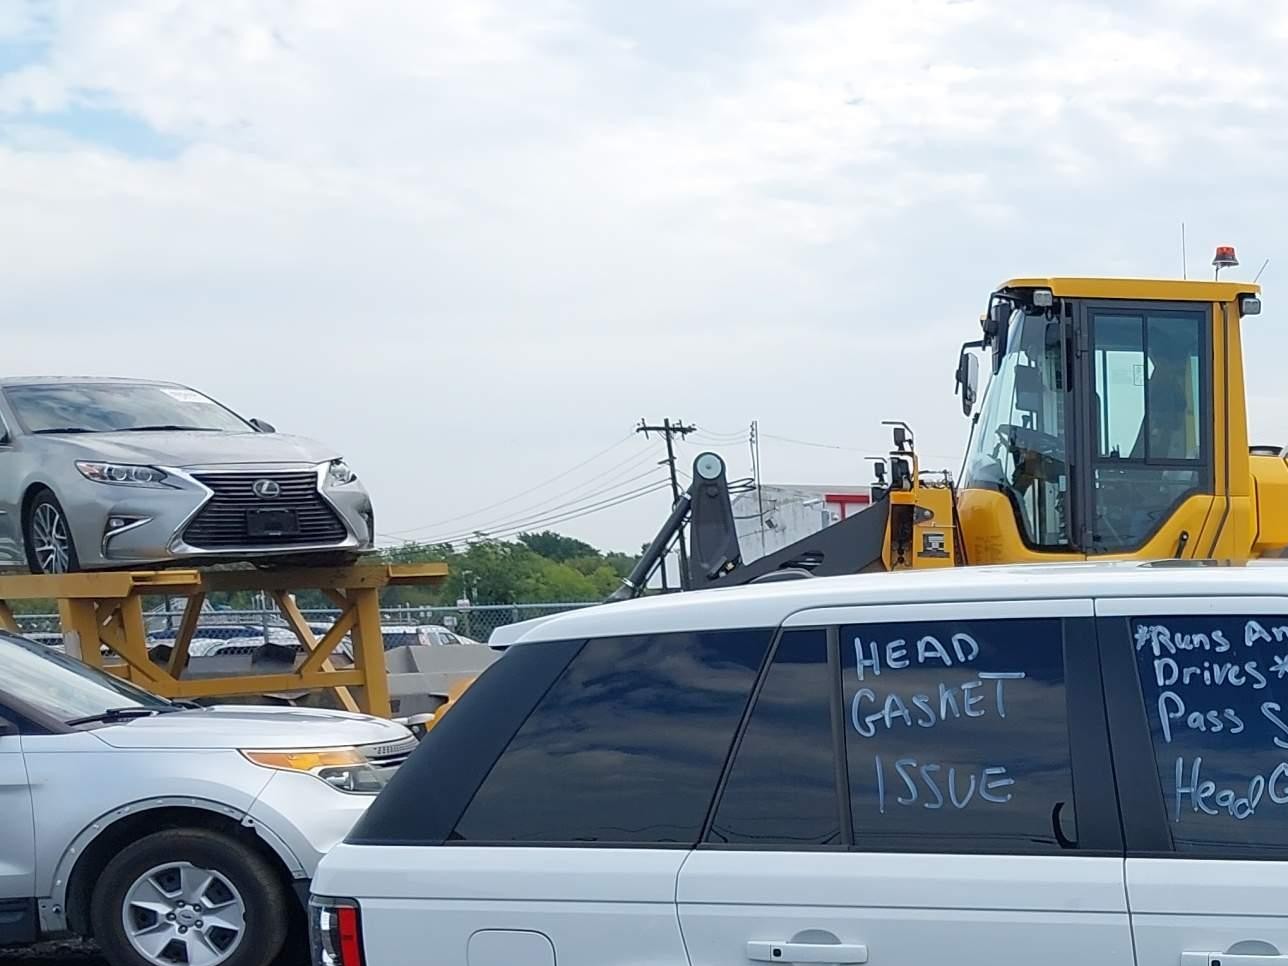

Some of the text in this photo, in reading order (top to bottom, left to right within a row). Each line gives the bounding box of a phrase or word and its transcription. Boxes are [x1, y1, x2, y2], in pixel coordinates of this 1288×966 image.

[854, 632, 980, 681] HEAD
[851, 672, 1026, 737] GASKET
[1157, 691, 1244, 743] Pass
[875, 754, 1015, 814] ISSUE
